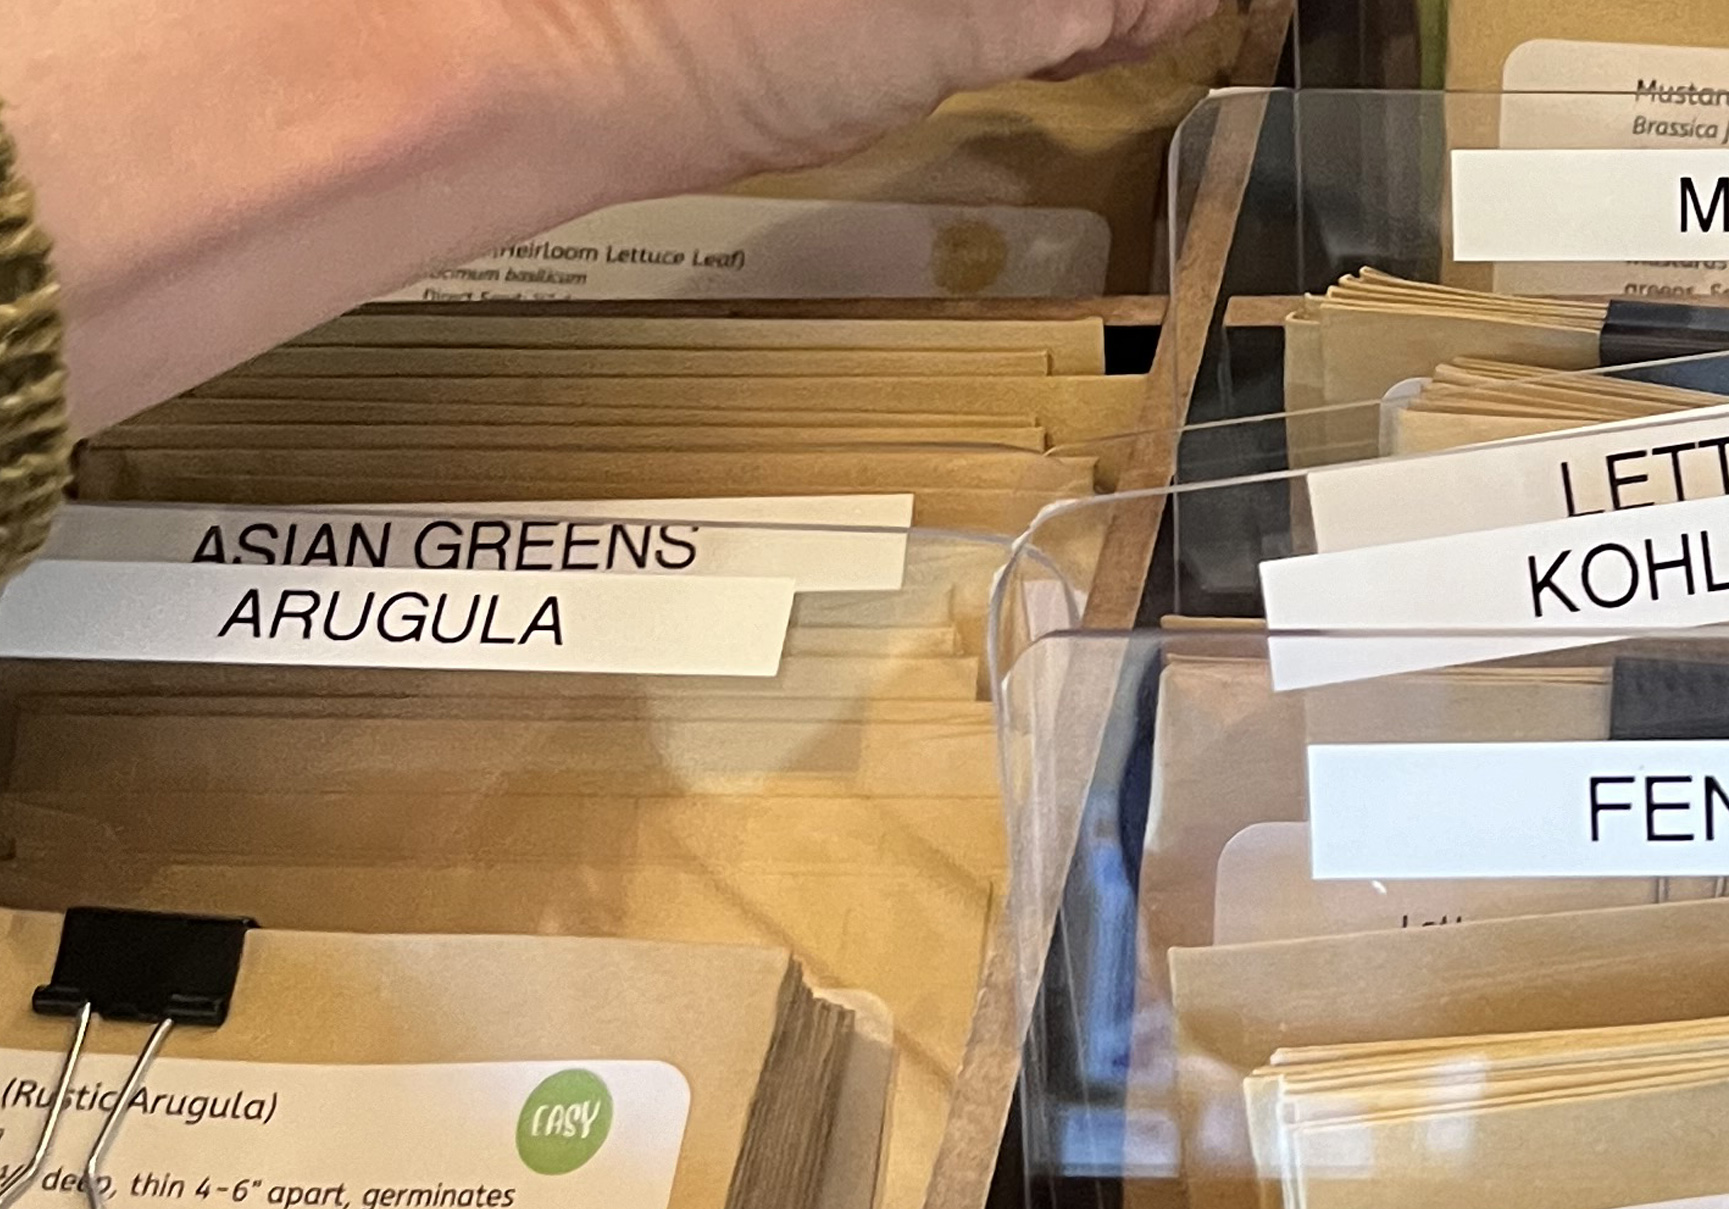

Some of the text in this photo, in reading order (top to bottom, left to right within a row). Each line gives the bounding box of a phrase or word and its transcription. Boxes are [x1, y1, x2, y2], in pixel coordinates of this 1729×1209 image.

[1632, 114, 1719, 140] Brassica
[606, 245, 685, 267] Lettuce
[191, 520, 698, 572] ASIAN GREENS
[216, 588, 563, 646] ARUGULA
[1, 1077, 278, 1125] (Rustic Arugula)
[531, 1098, 601, 1139] EASY
[130, 1172, 185, 1198] thin
[267, 1182, 351, 1209] apart,
[362, 1182, 516, 1209] germinates
